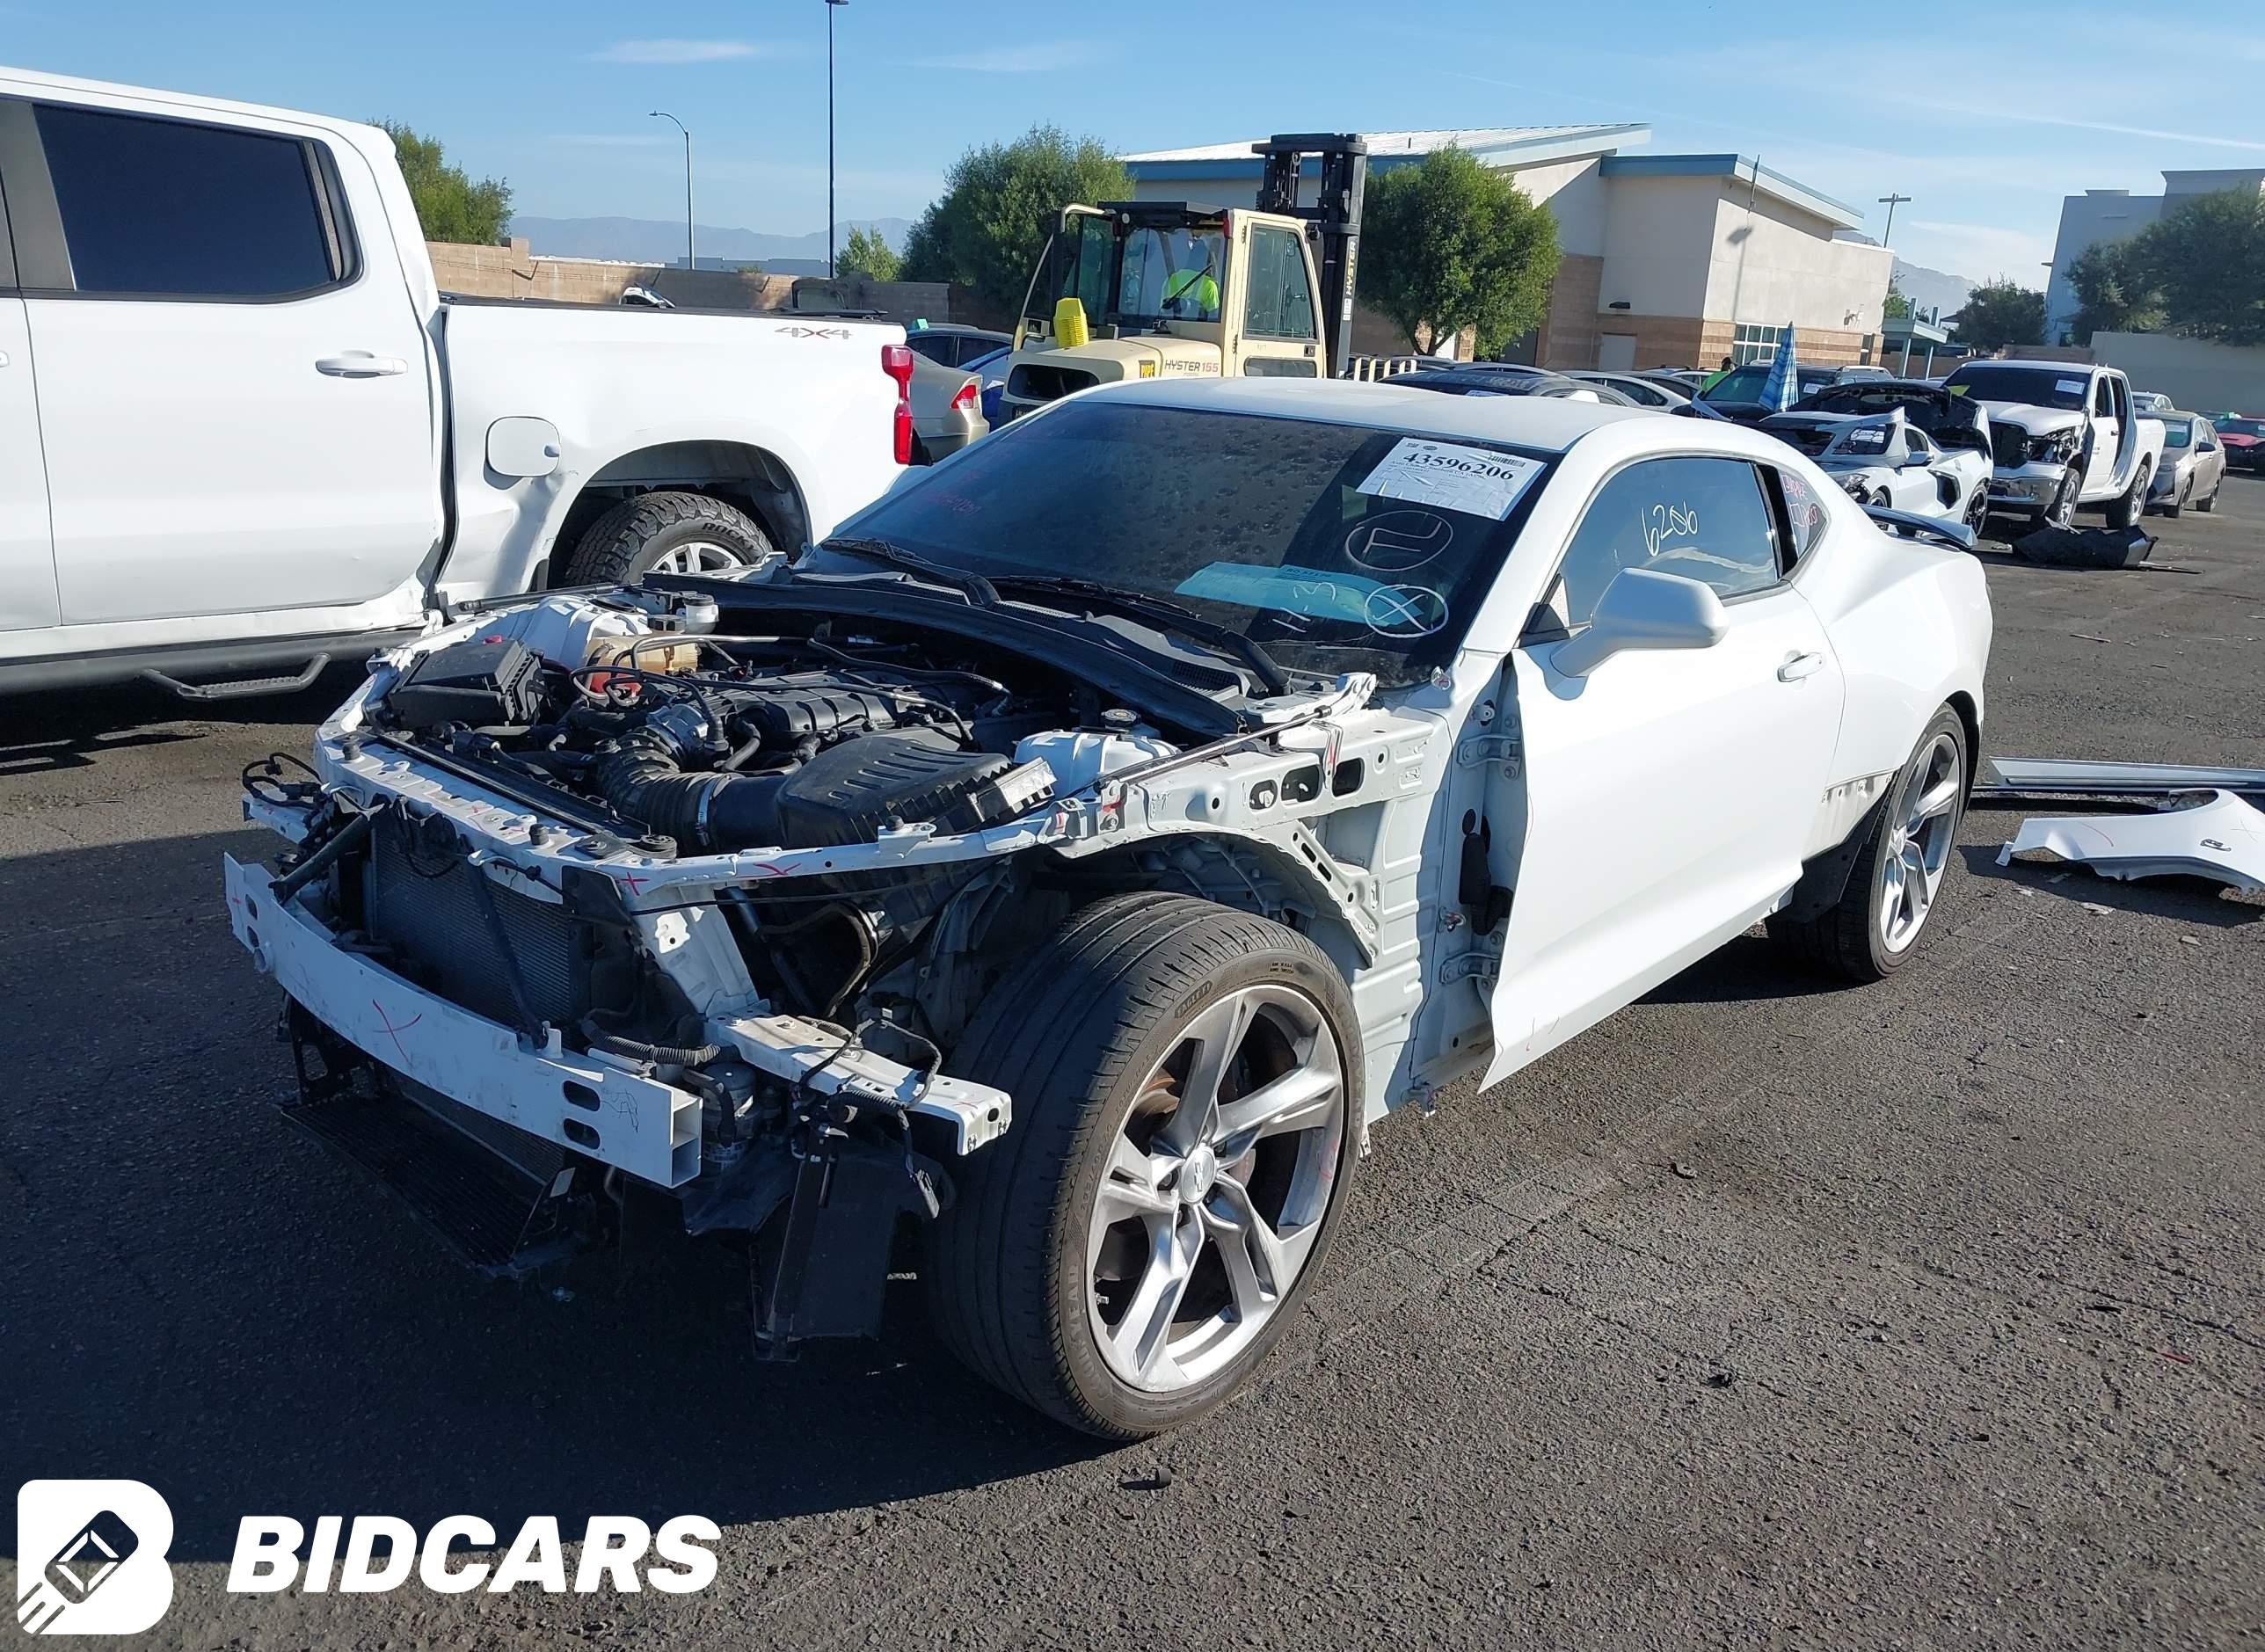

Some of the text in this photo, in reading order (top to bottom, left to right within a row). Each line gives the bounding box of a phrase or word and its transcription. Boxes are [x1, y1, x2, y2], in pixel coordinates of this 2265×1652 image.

[1345, 241, 1356, 296] HYSTER
[1164, 359, 1220, 373] HYSTER 155
[1403, 452, 1516, 481] 43596206
[1641, 500, 1698, 557] 6206
